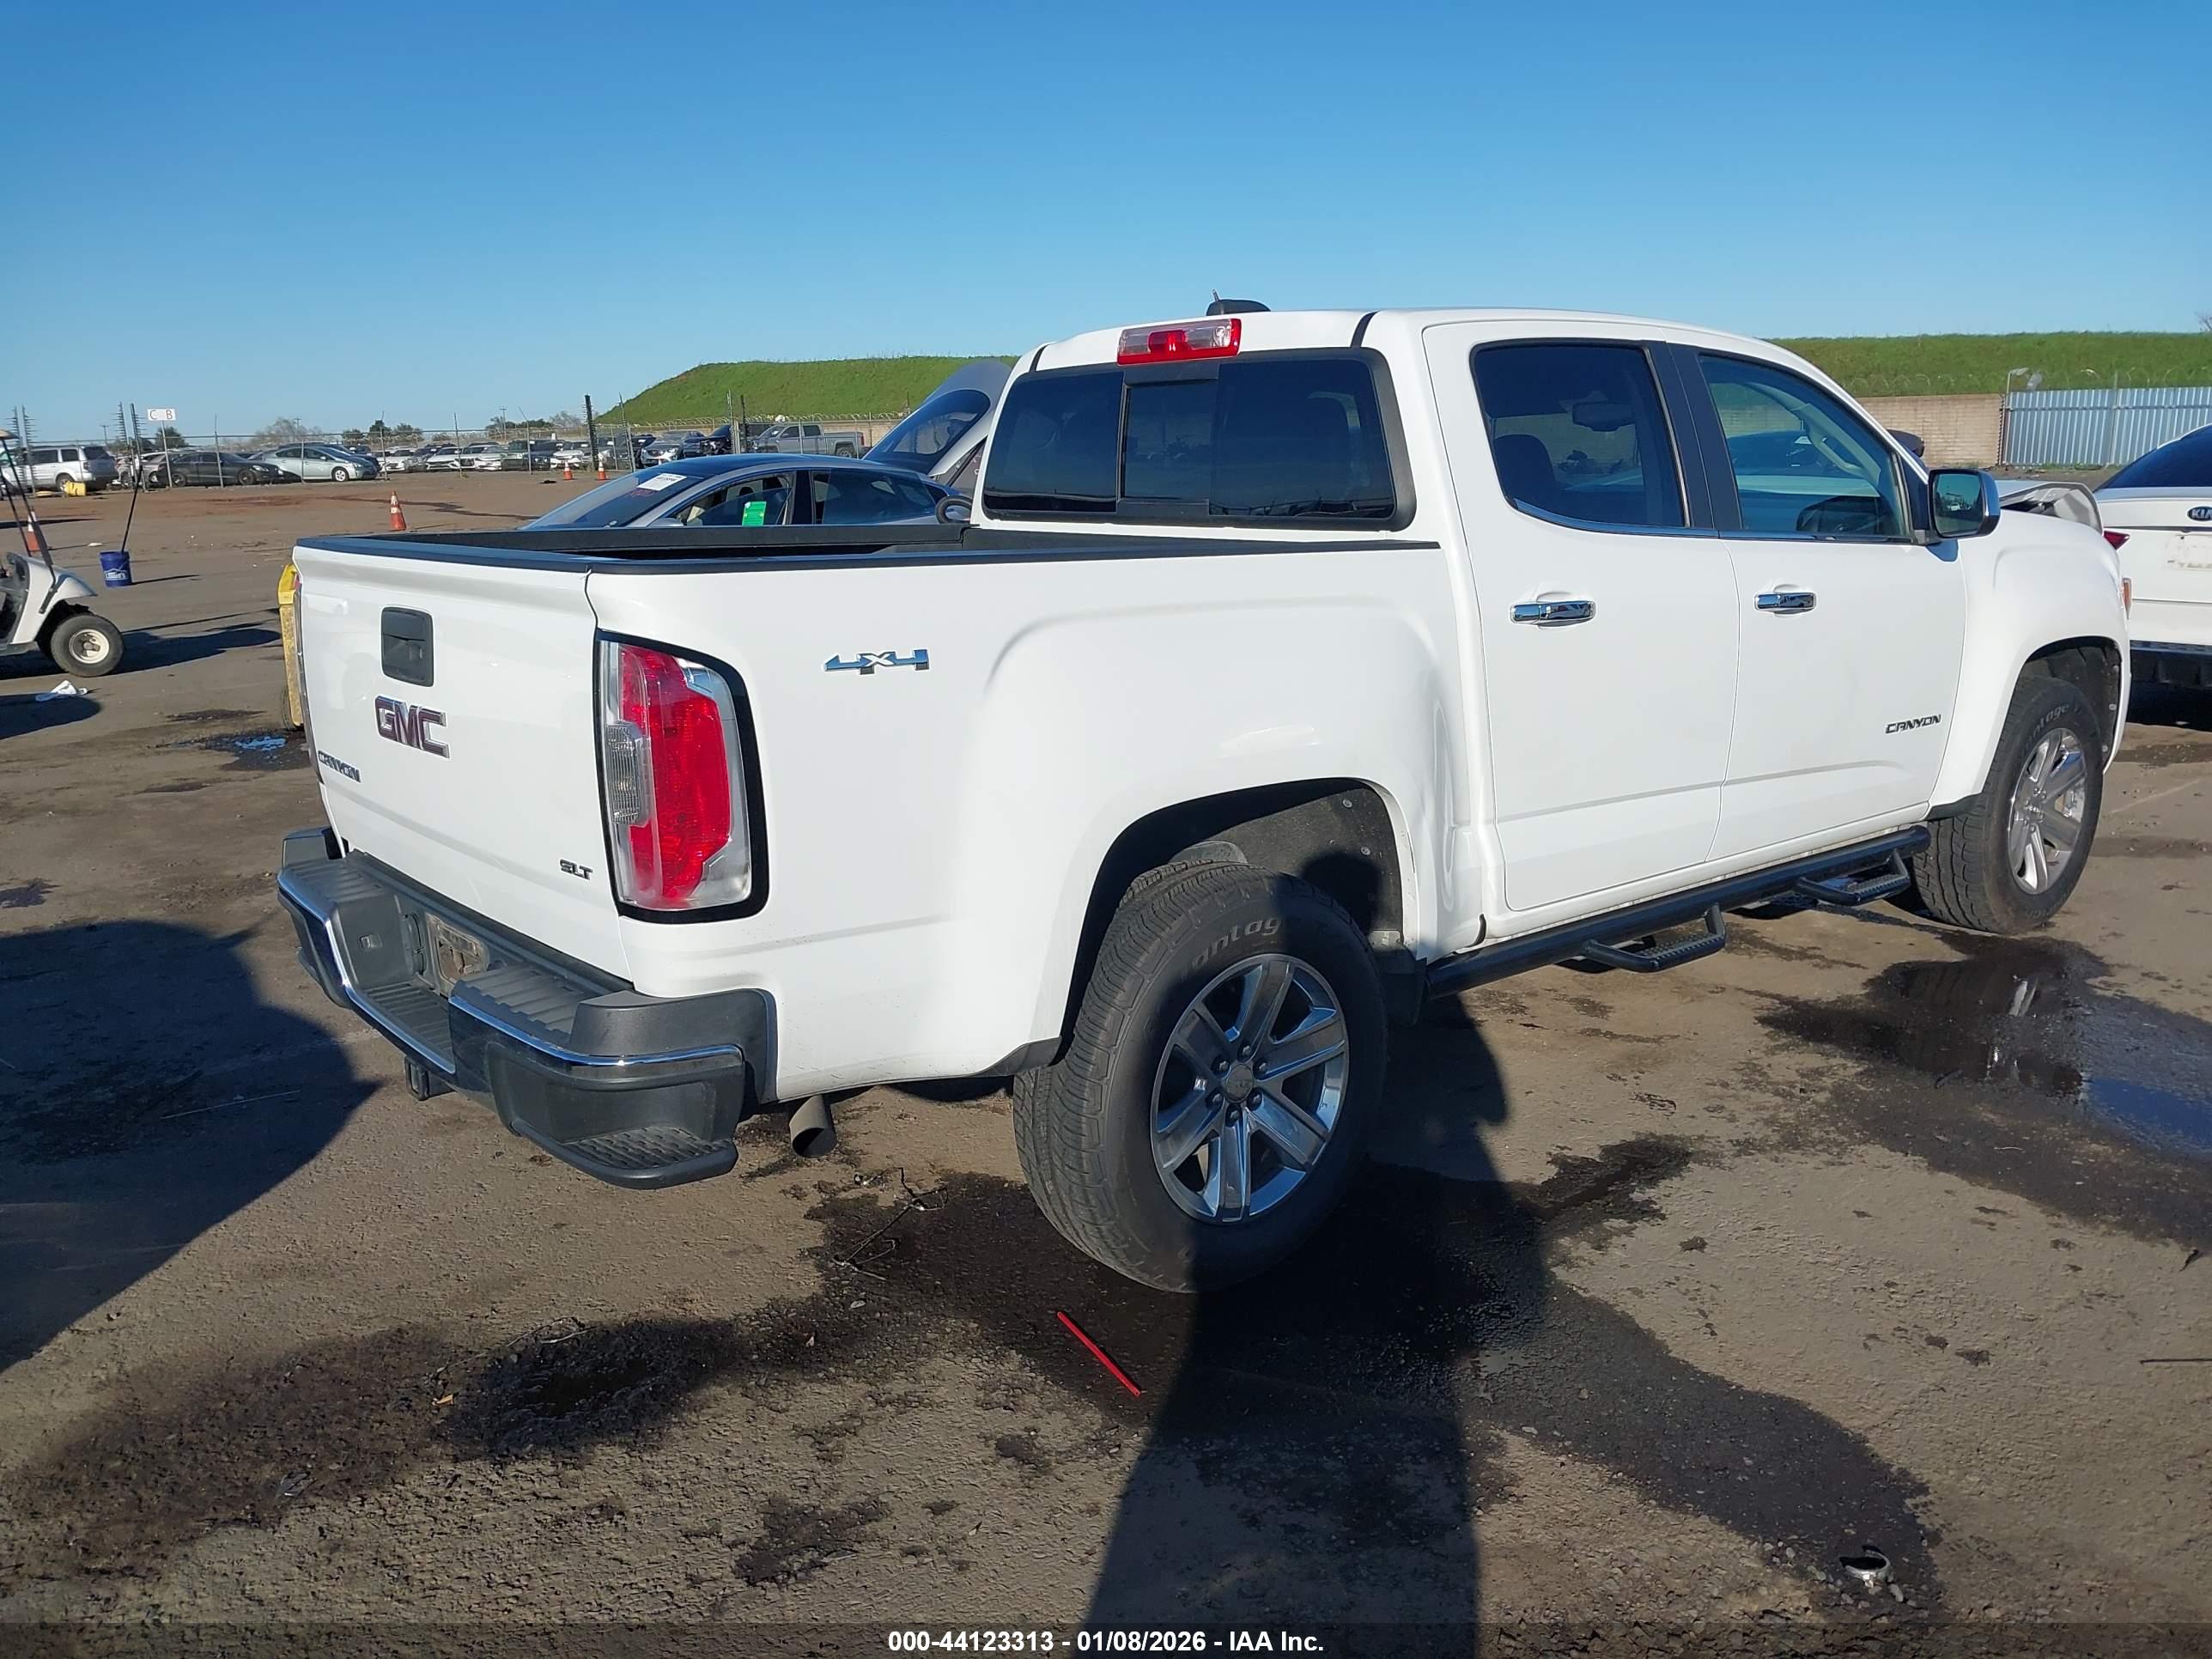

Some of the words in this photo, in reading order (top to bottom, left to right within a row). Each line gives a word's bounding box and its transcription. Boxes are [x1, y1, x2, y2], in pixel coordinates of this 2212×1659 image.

[166, 409, 173, 420] B
[2191, 508, 2212, 519] KIA
[374, 695, 450, 759] GMC
[1885, 714, 1942, 734] CANYON
[318, 750, 362, 783] CANYON
[559, 859, 593, 881] SLT
